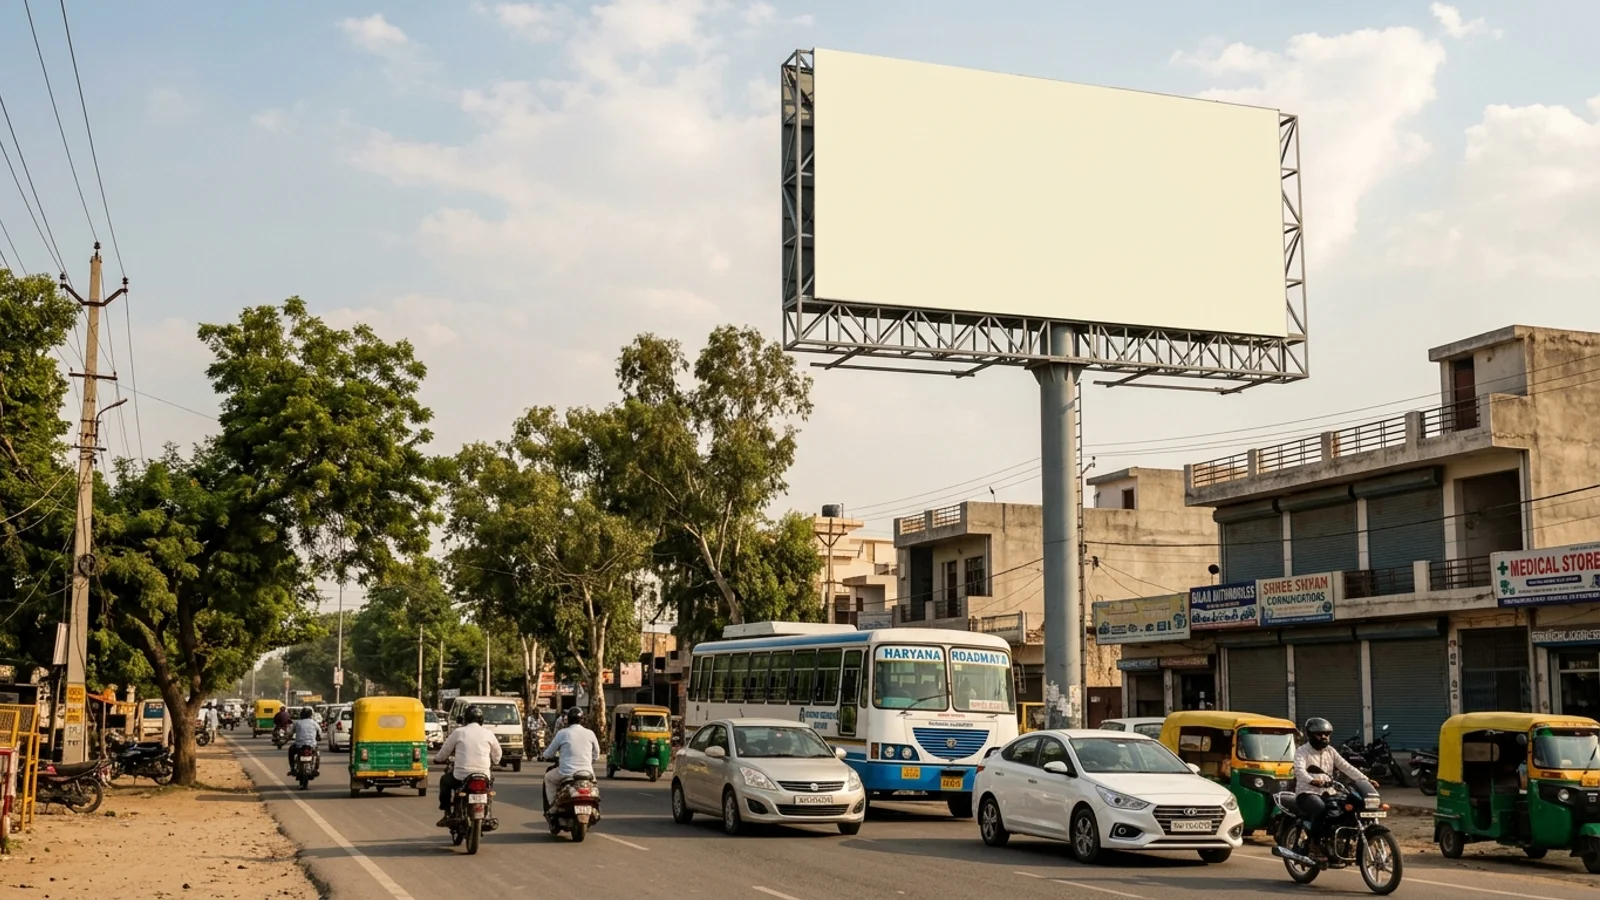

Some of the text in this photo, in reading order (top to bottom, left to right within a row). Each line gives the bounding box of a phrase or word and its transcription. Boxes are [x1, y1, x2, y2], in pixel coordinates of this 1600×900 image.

[1510, 551, 1600, 577] MEDICAL STORE
[884, 648, 941, 661] HARYANA
